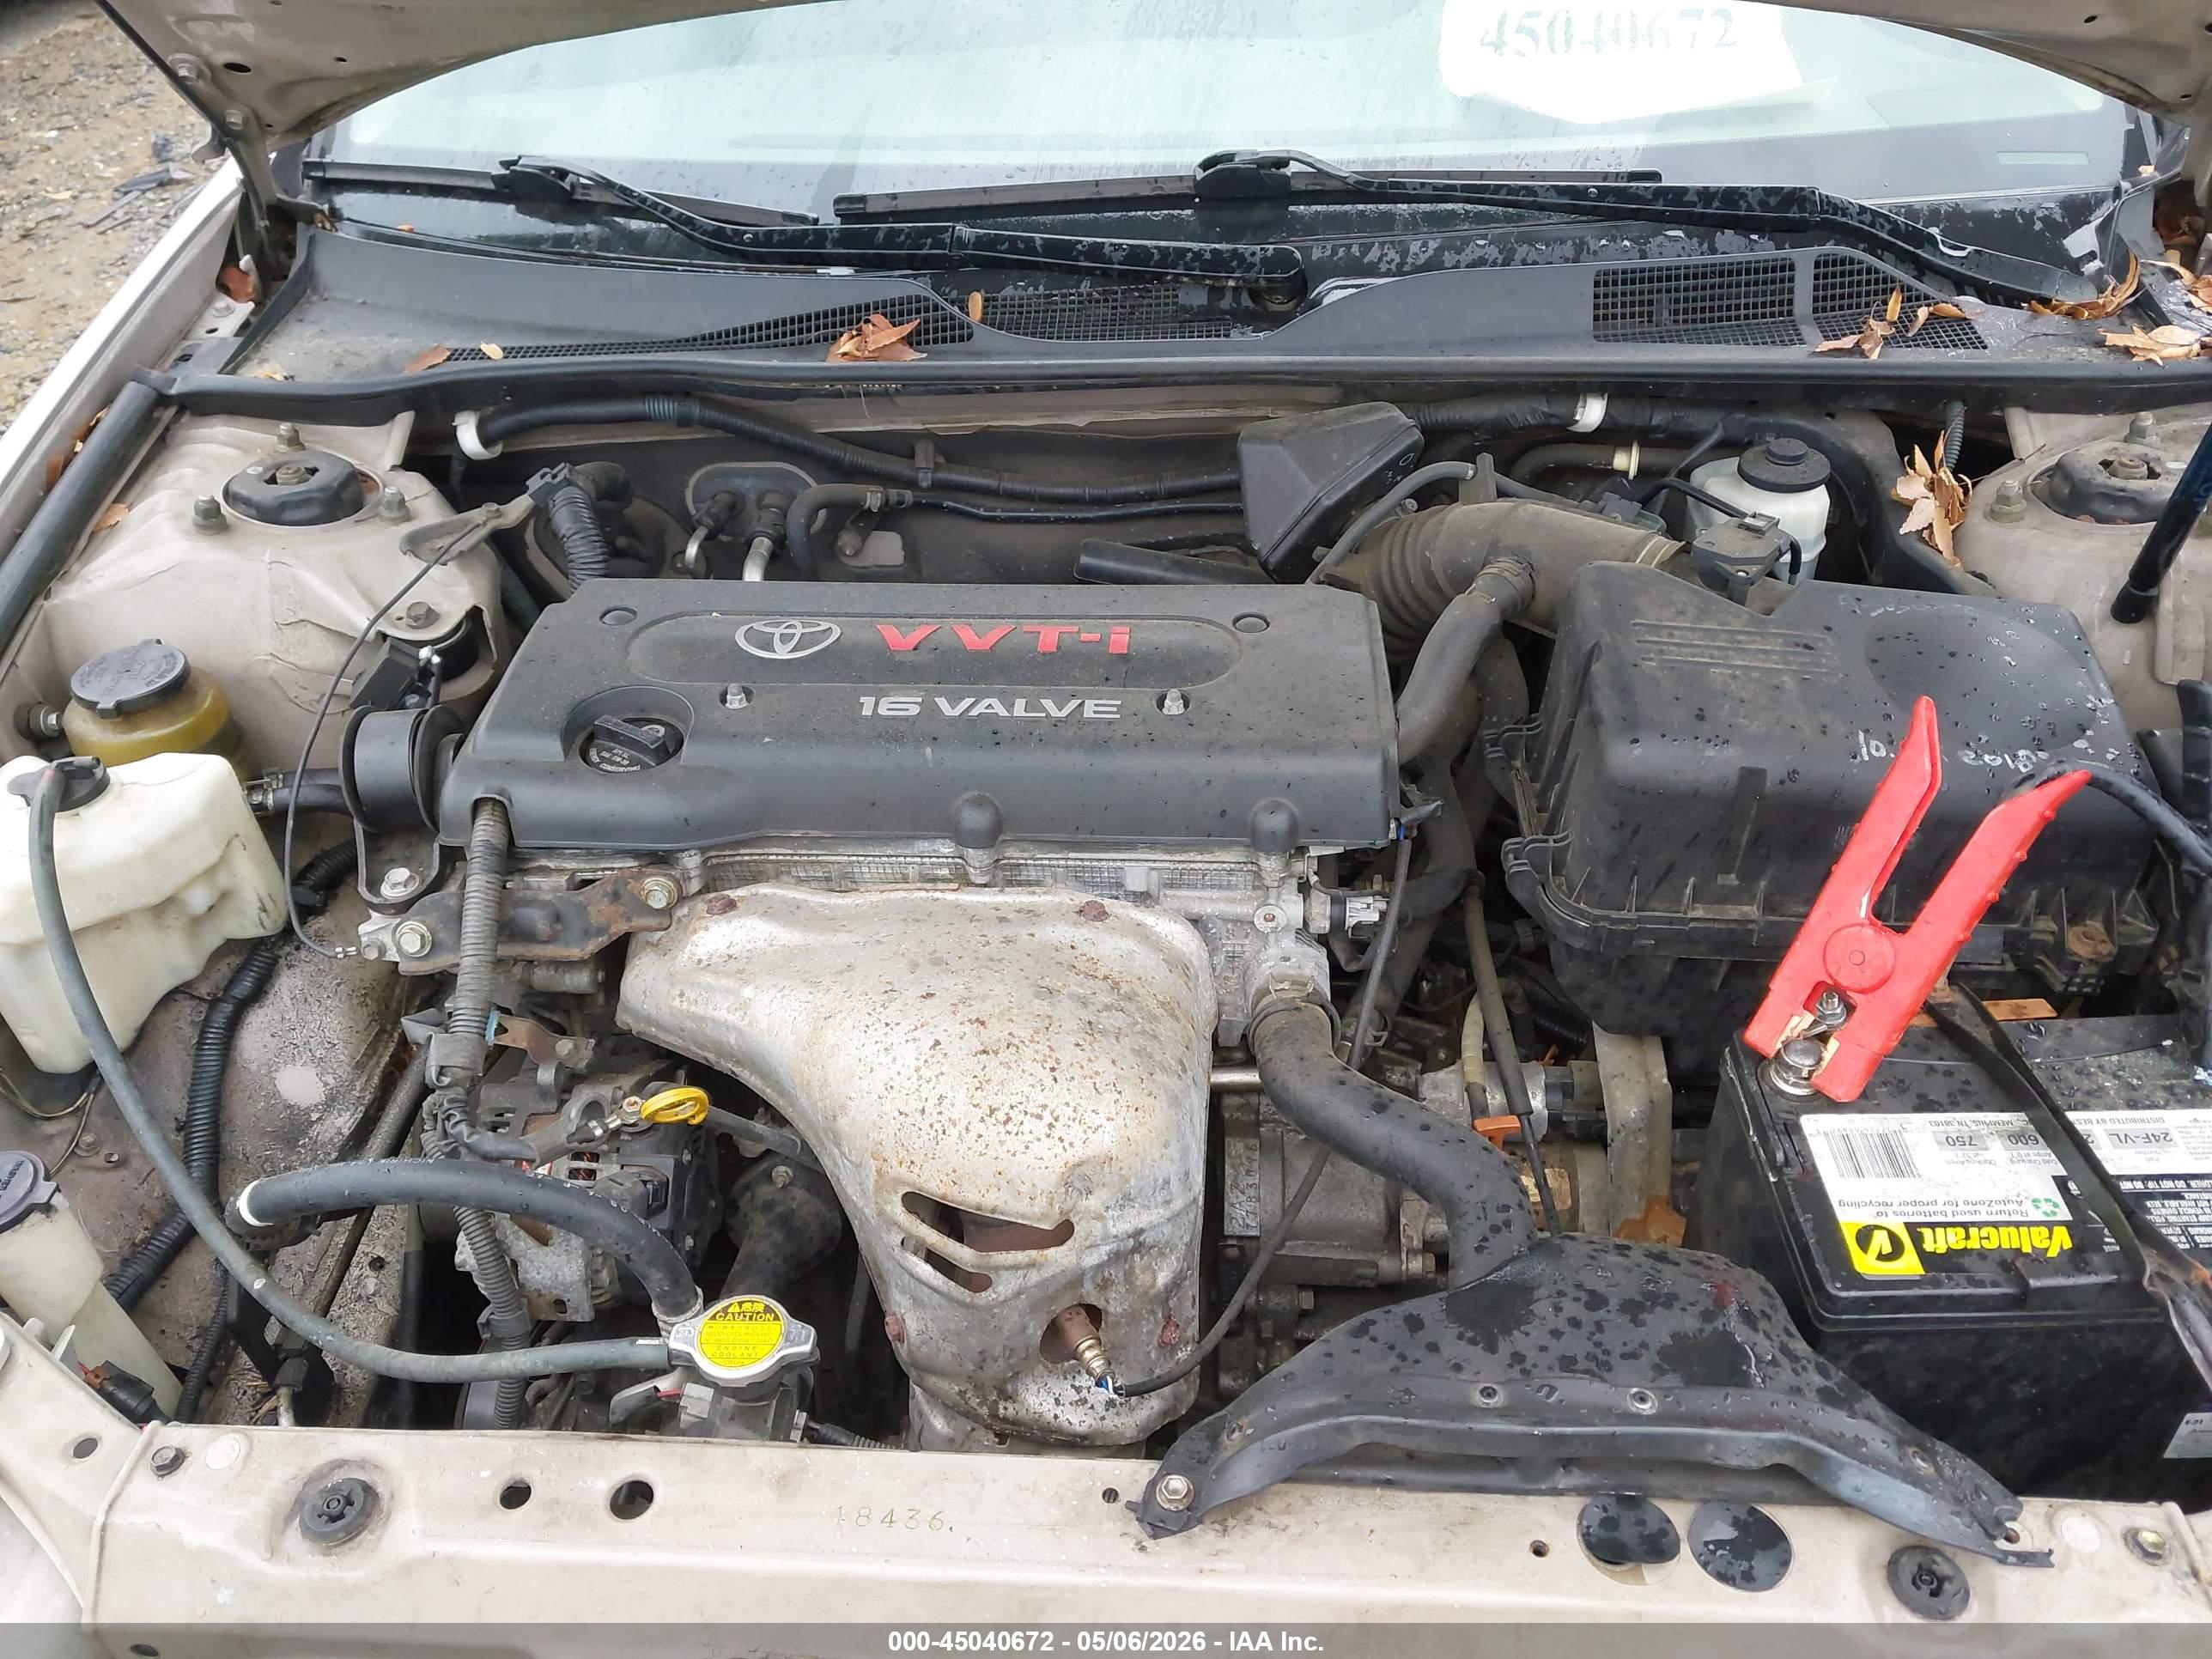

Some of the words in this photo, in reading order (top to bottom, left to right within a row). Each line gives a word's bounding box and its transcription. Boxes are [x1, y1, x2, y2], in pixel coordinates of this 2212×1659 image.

[1479, 8, 1737, 57] 45040672
[876, 624, 1131, 654] VVT-i
[860, 696, 922, 717] 16
[934, 697, 1122, 719] VALVE
[1946, 1135, 1978, 1146] 750
[2008, 1134, 2039, 1146] 600
[2109, 1132, 2173, 1145] 24F-VL
[1838, 1196, 1894, 1207] recycling
[1899, 1197, 1938, 1207] proper
[1943, 1197, 1957, 1206] for
[1963, 1197, 2024, 1206] AutoZone
[1892, 1208, 1948, 1218] batteries
[1952, 1208, 1982, 1218] used
[1987, 1208, 2029, 1218] Return
[1917, 1225, 2074, 1258] Valucraft
[740, 1302, 767, 1312] 危険
[715, 1313, 775, 1322] CAUTION
